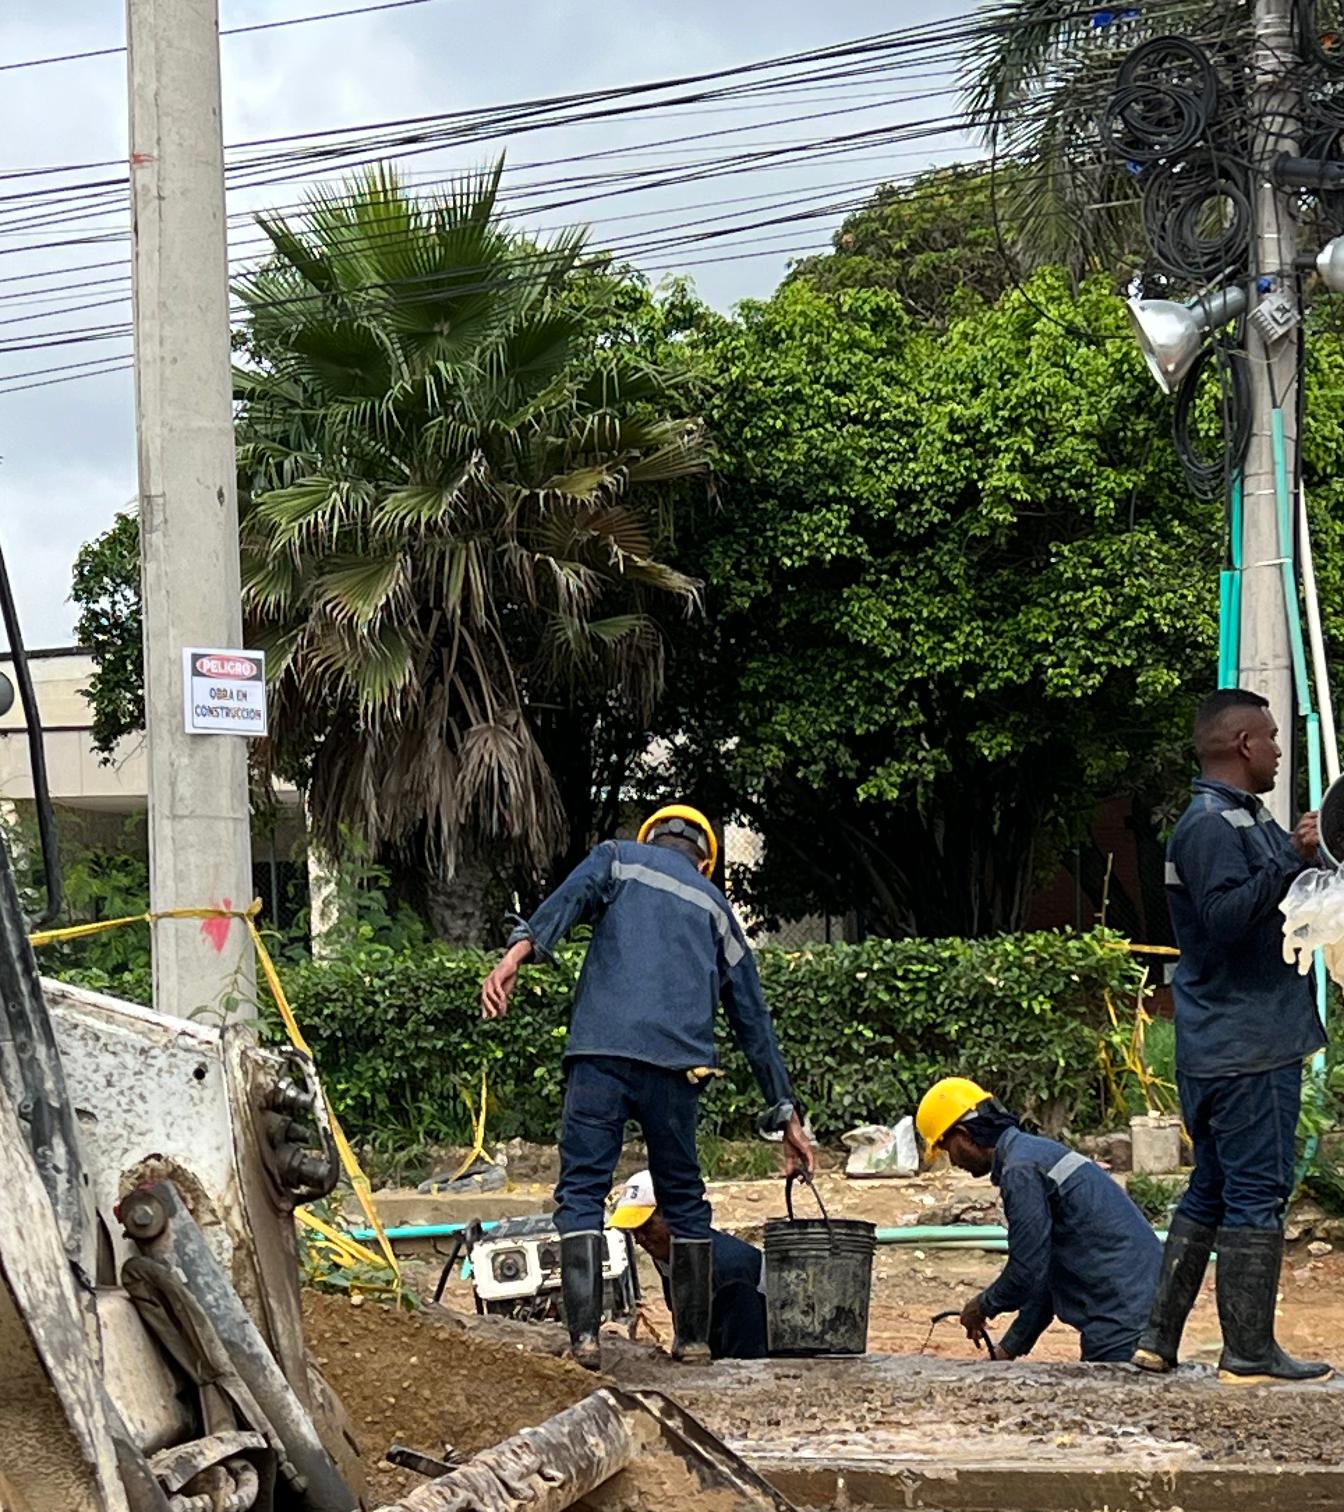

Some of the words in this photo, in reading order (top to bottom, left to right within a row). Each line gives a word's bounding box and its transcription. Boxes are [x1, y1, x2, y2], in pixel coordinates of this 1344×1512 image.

[203, 660, 251, 676] PELIGRO
[209, 687, 235, 701] OBRA
[236, 689, 248, 702] EN
